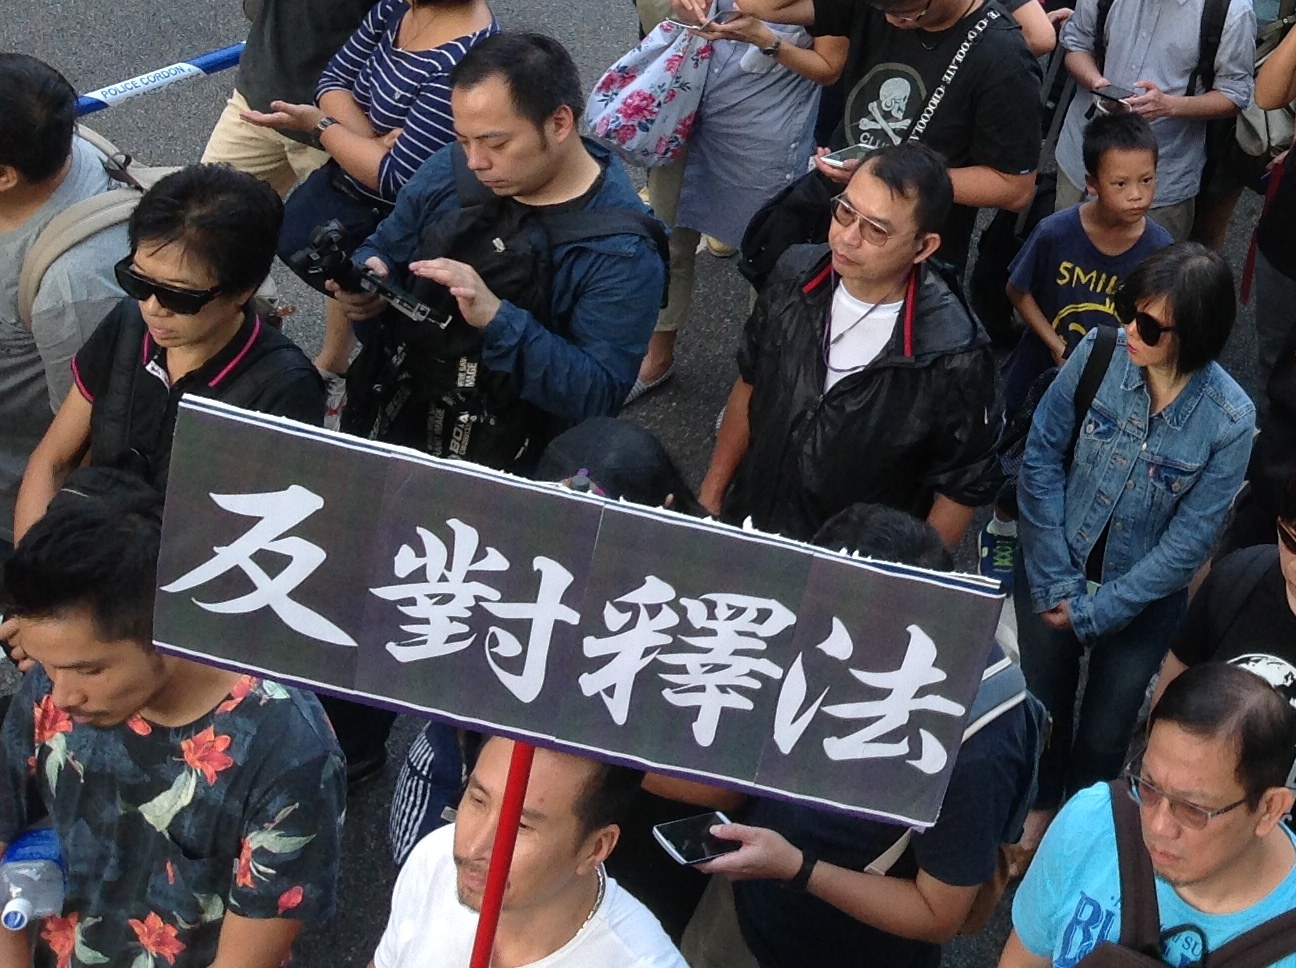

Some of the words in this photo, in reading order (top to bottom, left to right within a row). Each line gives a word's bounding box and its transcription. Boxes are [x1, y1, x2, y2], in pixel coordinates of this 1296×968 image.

[101, 80, 142, 99] POLICE
[139, 65, 185, 86] CORDON
[1056, 261, 1124, 295] SMIL
[161, 484, 966, 774] 反對釋法
